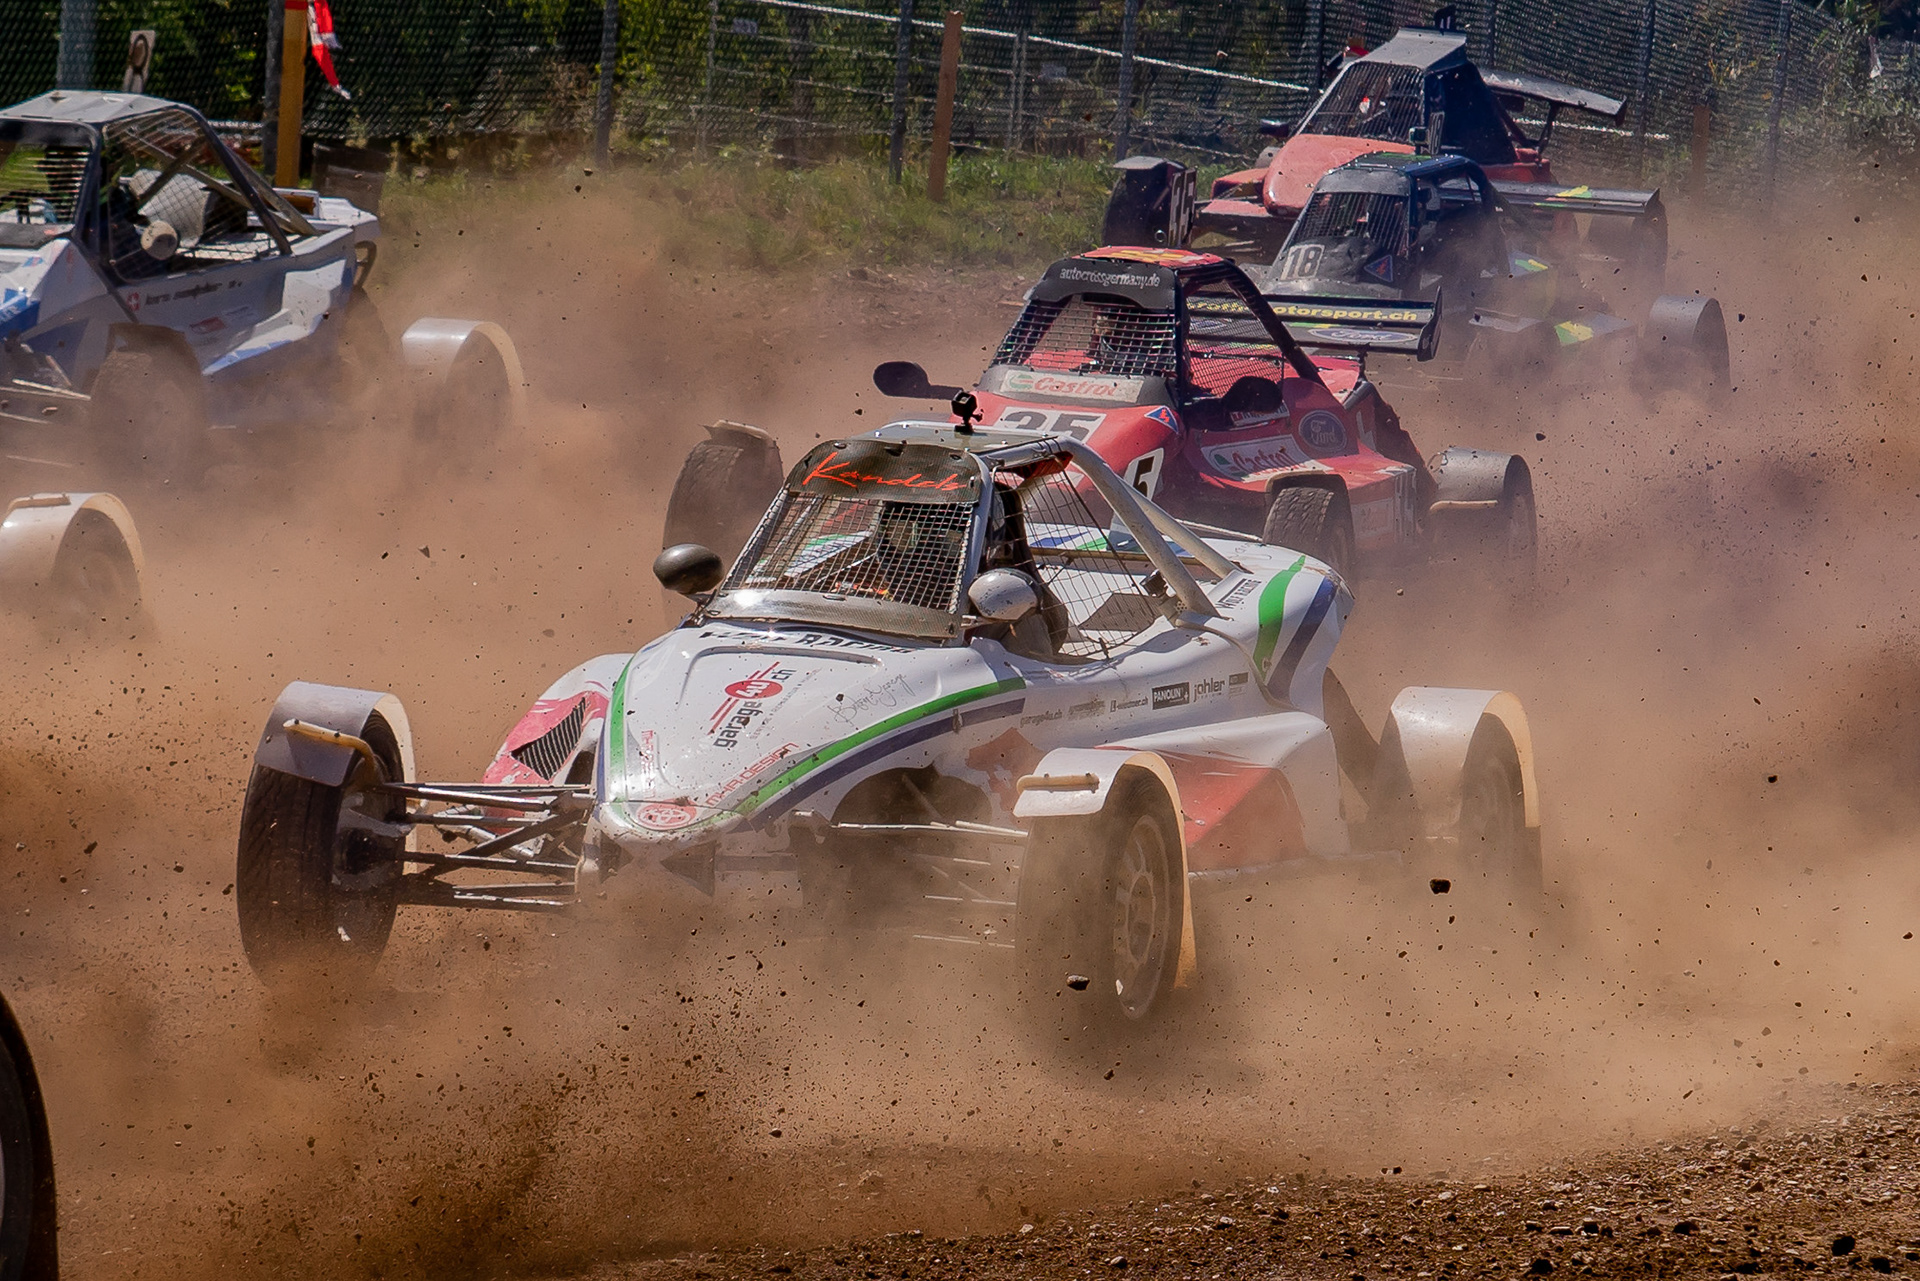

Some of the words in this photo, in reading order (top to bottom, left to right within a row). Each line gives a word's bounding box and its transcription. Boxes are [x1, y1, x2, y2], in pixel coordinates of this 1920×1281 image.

[1285, 246, 1322, 278] 18
[1060, 267, 1160, 290] autocrossgermany.de
[1333, 328, 1394, 341] Ford
[1034, 376, 1119, 397] Castrol
[1001, 411, 1102, 444] 25
[1310, 417, 1337, 445] Ford
[1231, 446, 1306, 476] Castrol
[1193, 677, 1226, 702] johler
